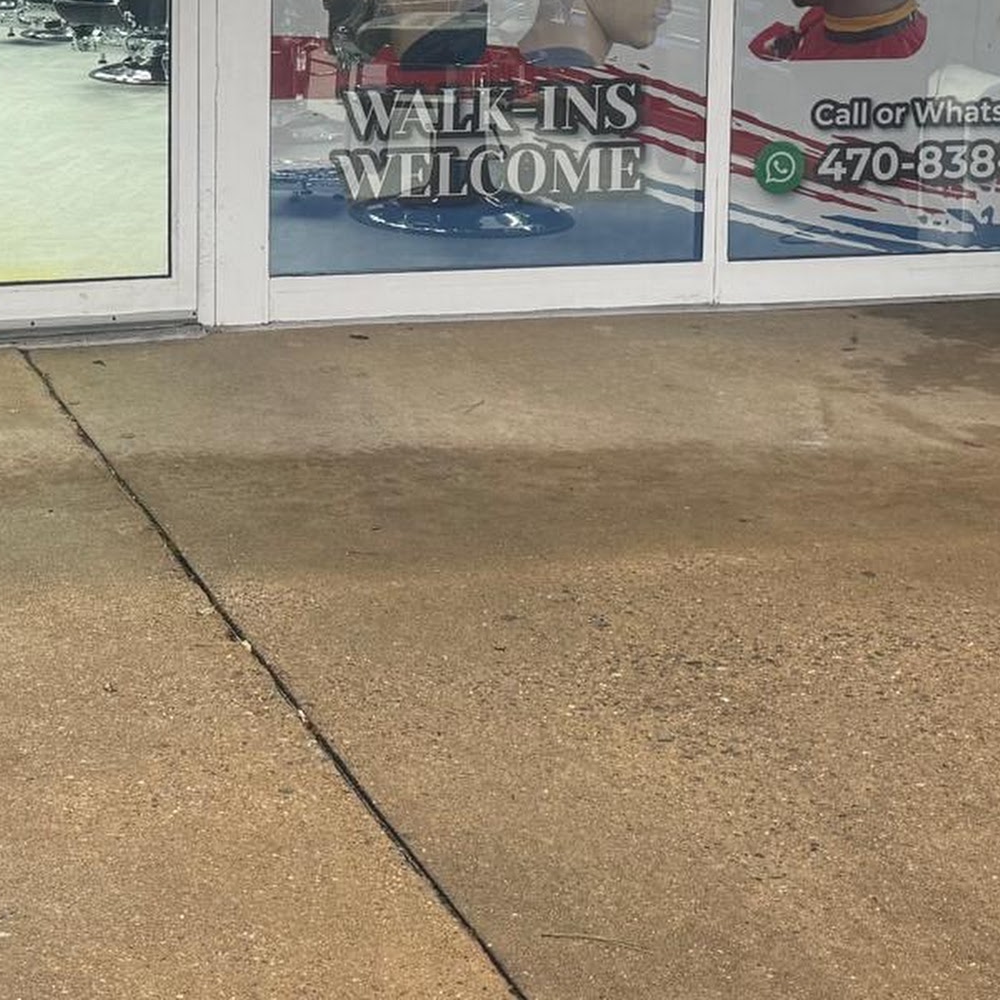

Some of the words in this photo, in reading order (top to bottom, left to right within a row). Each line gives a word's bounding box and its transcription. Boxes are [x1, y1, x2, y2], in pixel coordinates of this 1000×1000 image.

[343, 81, 639, 137] WALK-INS
[814, 101, 867, 126] Call
[876, 107, 906, 125] or
[335, 146, 642, 200] WELCOME
[817, 144, 1000, 182] 470-838
